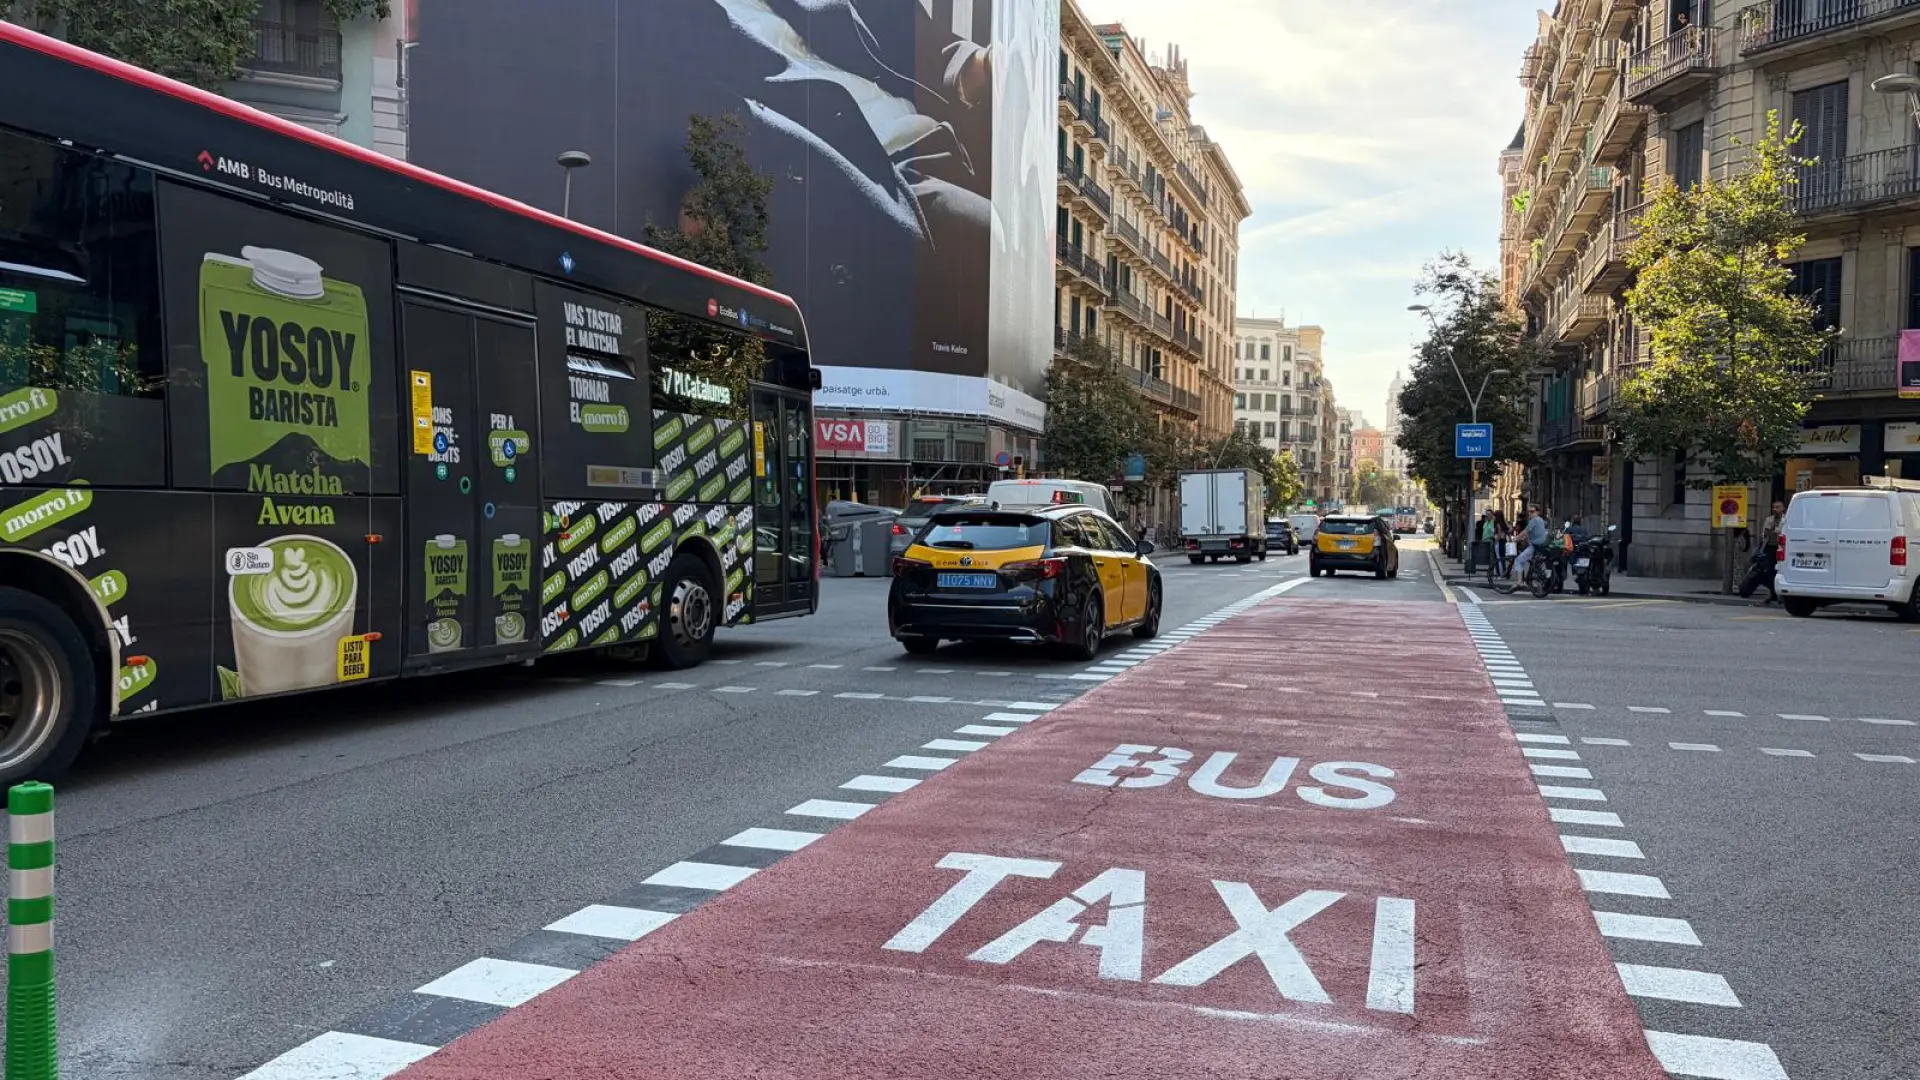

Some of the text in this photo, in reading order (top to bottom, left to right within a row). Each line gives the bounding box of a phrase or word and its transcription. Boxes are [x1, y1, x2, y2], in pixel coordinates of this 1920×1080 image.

[217, 157, 354, 210] AMB Bus Metropolità
[564, 302, 622, 335] VAS TASTAR
[579, 330, 619, 354] MATCHA
[932, 341, 967, 355] Travis Kelce
[569, 376, 609, 403] TORNAR
[822, 384, 863, 397] paisatge
[249, 386, 338, 427] BARISTA
[570, 401, 627, 426] EL morro fi
[491, 413, 515, 431] PER A
[820, 423, 862, 442] VSA
[1466, 444, 1482, 452] taxi
[248, 464, 343, 495] Matcha
[5, 496, 66, 533] morro
[258, 497, 335, 525] Avena
[247, 552, 259, 561] Sin
[247, 560, 270, 569] Gluten
[429, 555, 464, 574] YOSOY
[497, 552, 528, 571] YOSOY
[579, 599, 612, 638] YOSOY
[344, 641, 364, 652] LISTO
[344, 652, 362, 664] PARA
[343, 664, 365, 676] BEBER
[1071, 744, 1396, 810] BUS
[881, 852, 1415, 1014] TAXI
